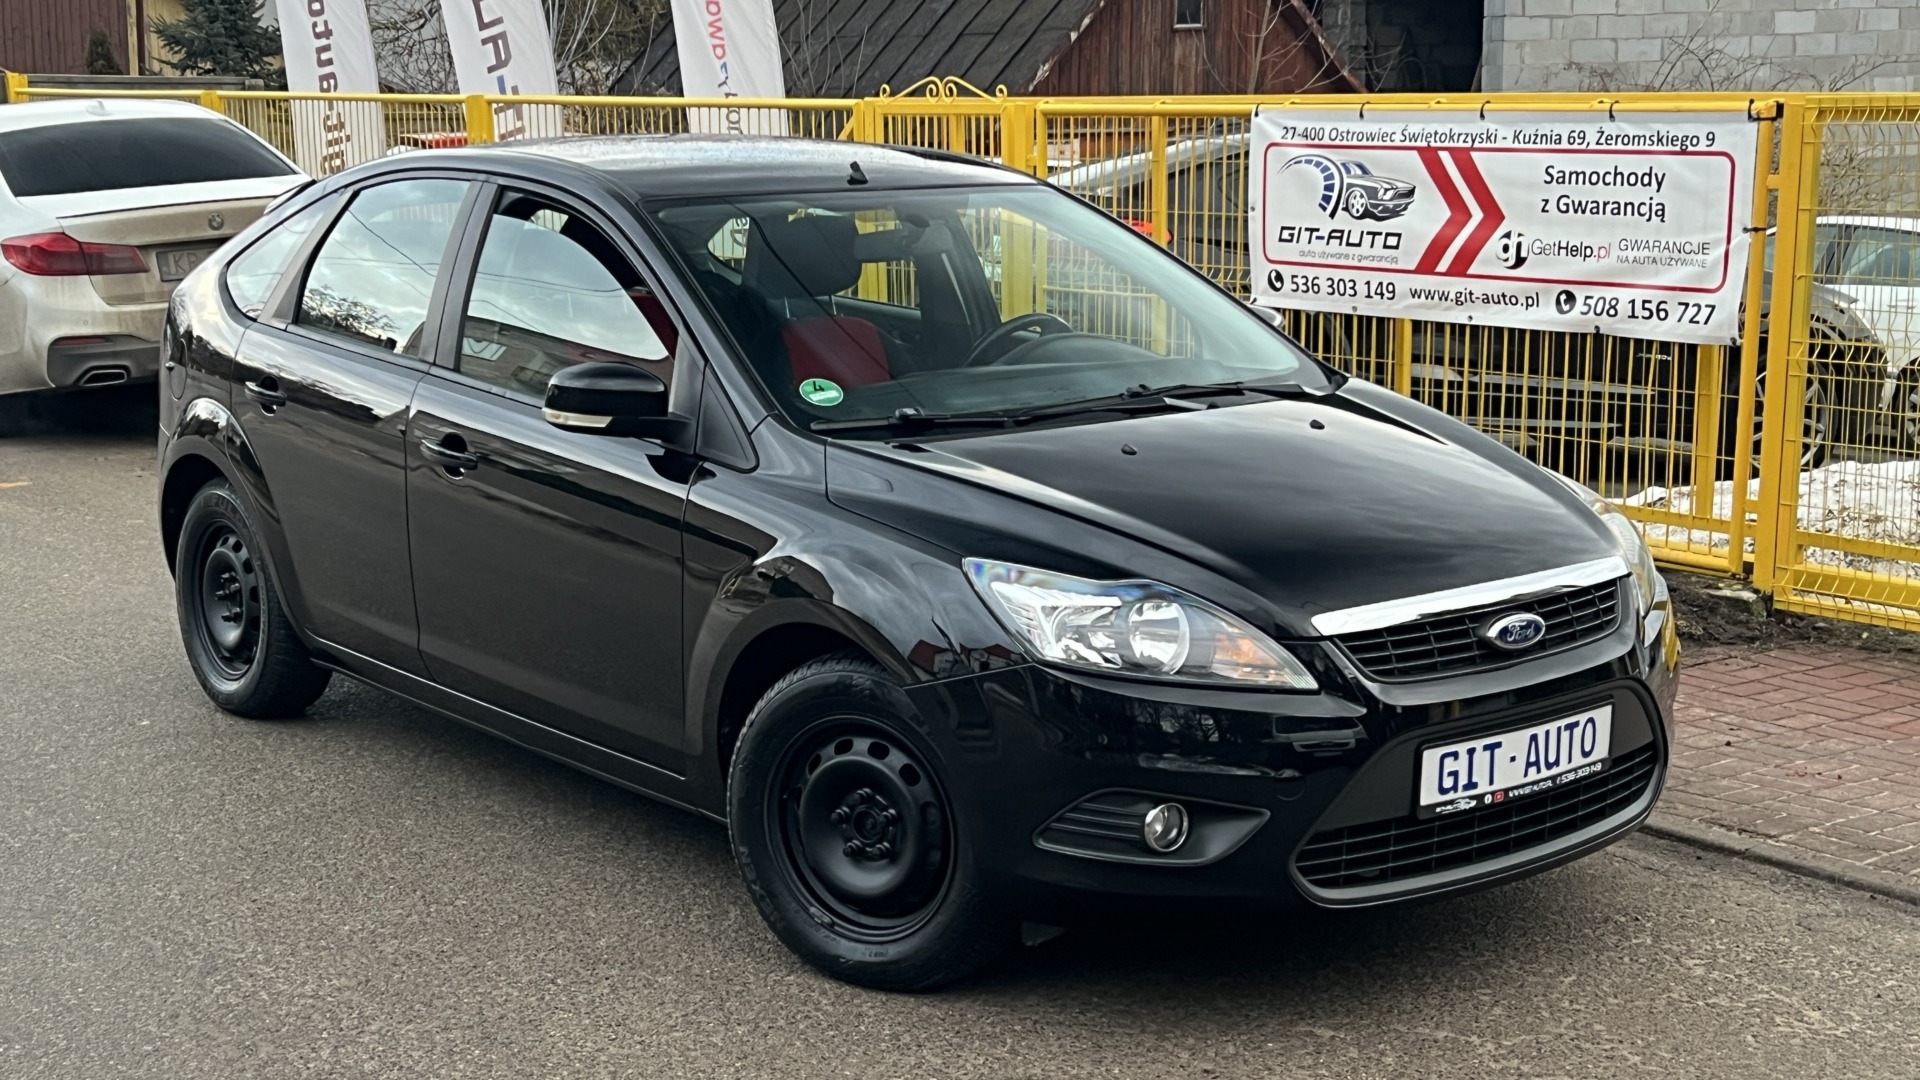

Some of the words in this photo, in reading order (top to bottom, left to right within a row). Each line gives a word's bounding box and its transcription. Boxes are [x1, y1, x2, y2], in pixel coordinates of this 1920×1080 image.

[1281, 127, 1325, 142] 27-400
[1328, 128, 1397, 144] Ostrowiec
[1400, 125, 1499, 148] Świętokrzyski
[1512, 129, 1562, 146] Kuźnia
[1567, 130, 1591, 149] 69,
[1596, 127, 1700, 151] Żeromskiego
[1706, 131, 1716, 148] 9
[1544, 165, 1666, 193] Samochody
[1541, 199, 1550, 213] z
[1556, 195, 1666, 223] Gwarancją
[1278, 226, 1402, 250] GIT-AUTO
[1618, 238, 1711, 255] GWARANCJE
[1531, 239, 1611, 263] GetHelp.pl
[1616, 255, 1630, 264] NA
[1631, 255, 1658, 265] AUTA
[1290, 275, 1320, 294] 536
[1326, 277, 1358, 297] 303
[1364, 280, 1396, 301] 149
[1409, 287, 1540, 311] www.git-auto.pl
[1580, 295, 1619, 318] 508
[1627, 299, 1669, 321] 156
[1676, 301, 1716, 326] 727
[1507, 621, 1535, 642] Ford
